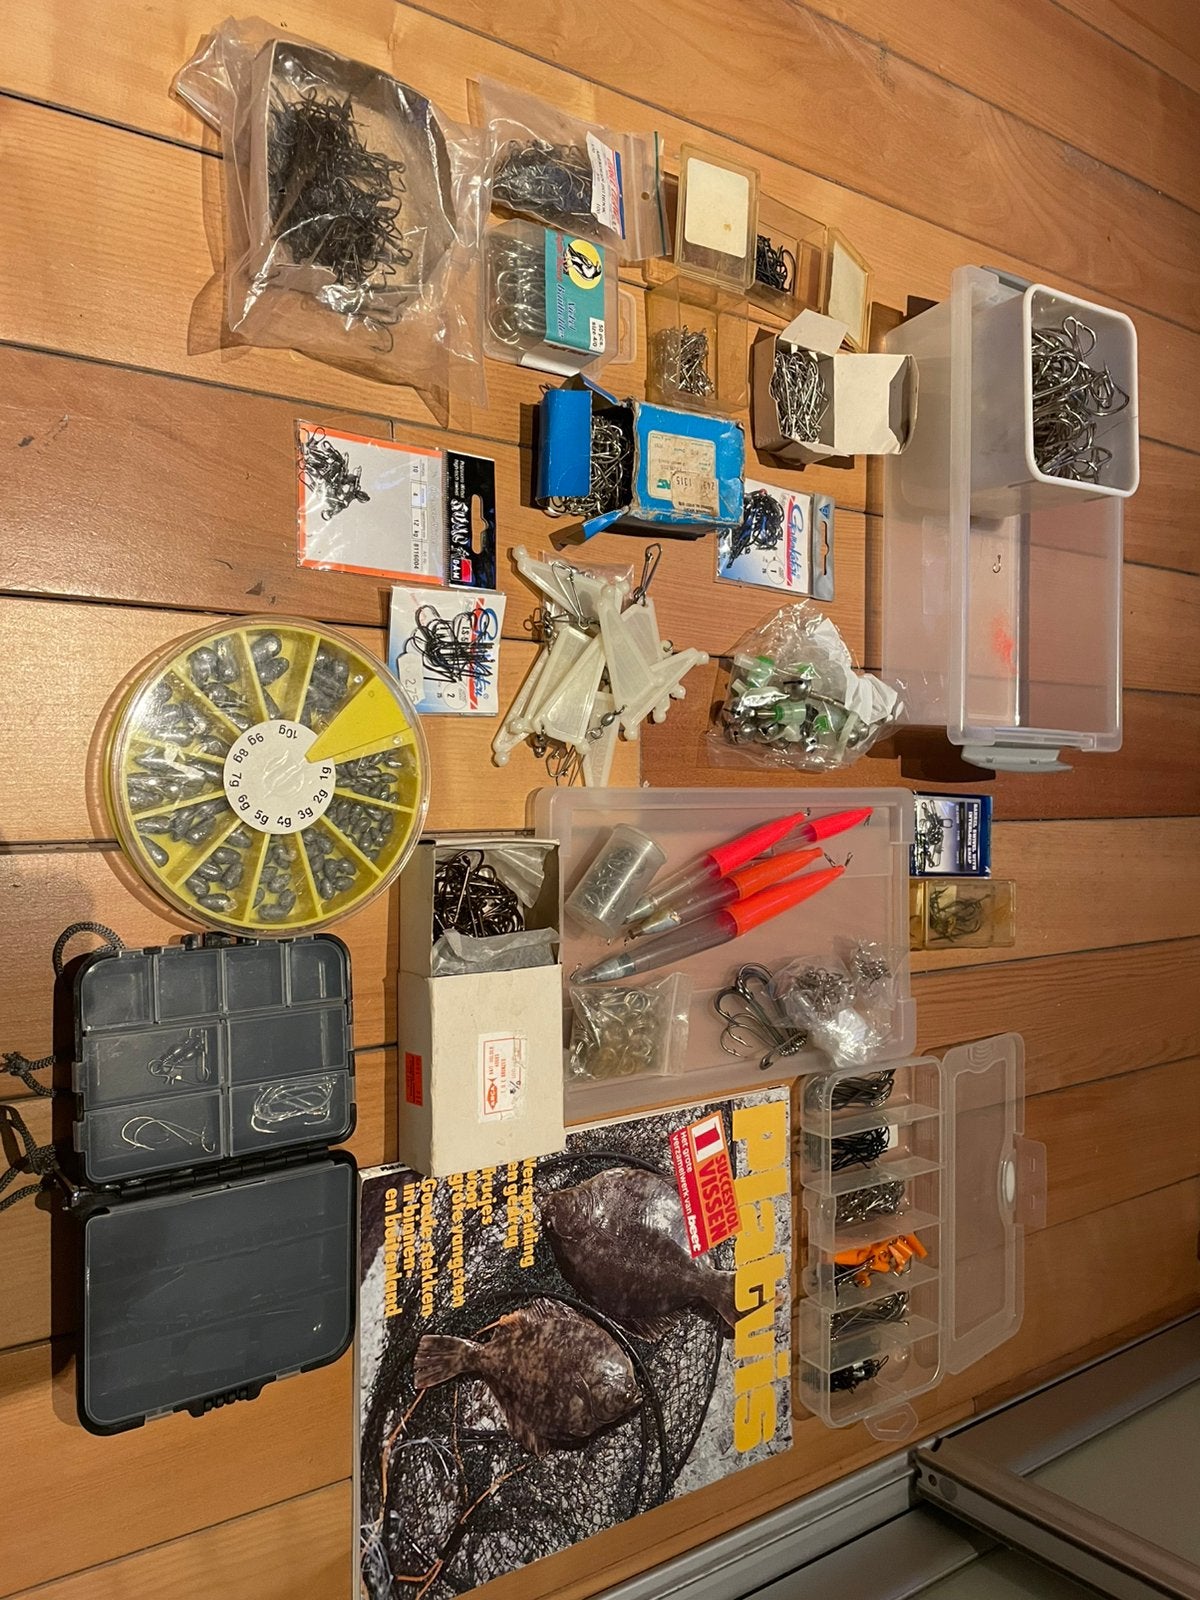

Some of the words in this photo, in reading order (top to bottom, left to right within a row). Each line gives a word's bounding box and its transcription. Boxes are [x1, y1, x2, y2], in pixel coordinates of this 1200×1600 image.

[788, 504, 803, 577] Gamakatsu
[248, 733, 264, 746] 9g
[279, 724, 298, 739] 10g
[233, 748, 249, 764] 8g
[229, 772, 242, 787] 7g
[320, 766, 332, 780] 1g
[238, 794, 251, 811] 6g
[313, 789, 328, 804] 2g
[254, 810, 269, 825] 5g
[277, 815, 292, 828] 4g
[298, 806, 314, 820] 3g
[680, 1131, 689, 1147] Het
[694, 1122, 721, 1155] 1
[507, 1162, 519, 1182] en
[673, 1135, 689, 1197] verzamelwerk
[682, 1148, 693, 1173] grote
[384, 1188, 399, 1212] en
[403, 1182, 420, 1201] in
[446, 1174, 465, 1222] grote
[699, 1159, 727, 1243] VISSEN
[715, 1154, 739, 1233] SUCCESVOL
[420, 1178, 438, 1237] Goede
[503, 1184, 520, 1249] gedrag
[519, 1156, 539, 1268] Verspreiding
[684, 1198, 692, 1214] van
[402, 1205, 419, 1278] binnen-
[687, 1215, 702, 1252] beet
[384, 1215, 403, 1317] buitenland
[447, 1225, 466, 1308] vangsten
[732, 1099, 791, 1454] Platvis
[420, 1243, 437, 1318] stekken
